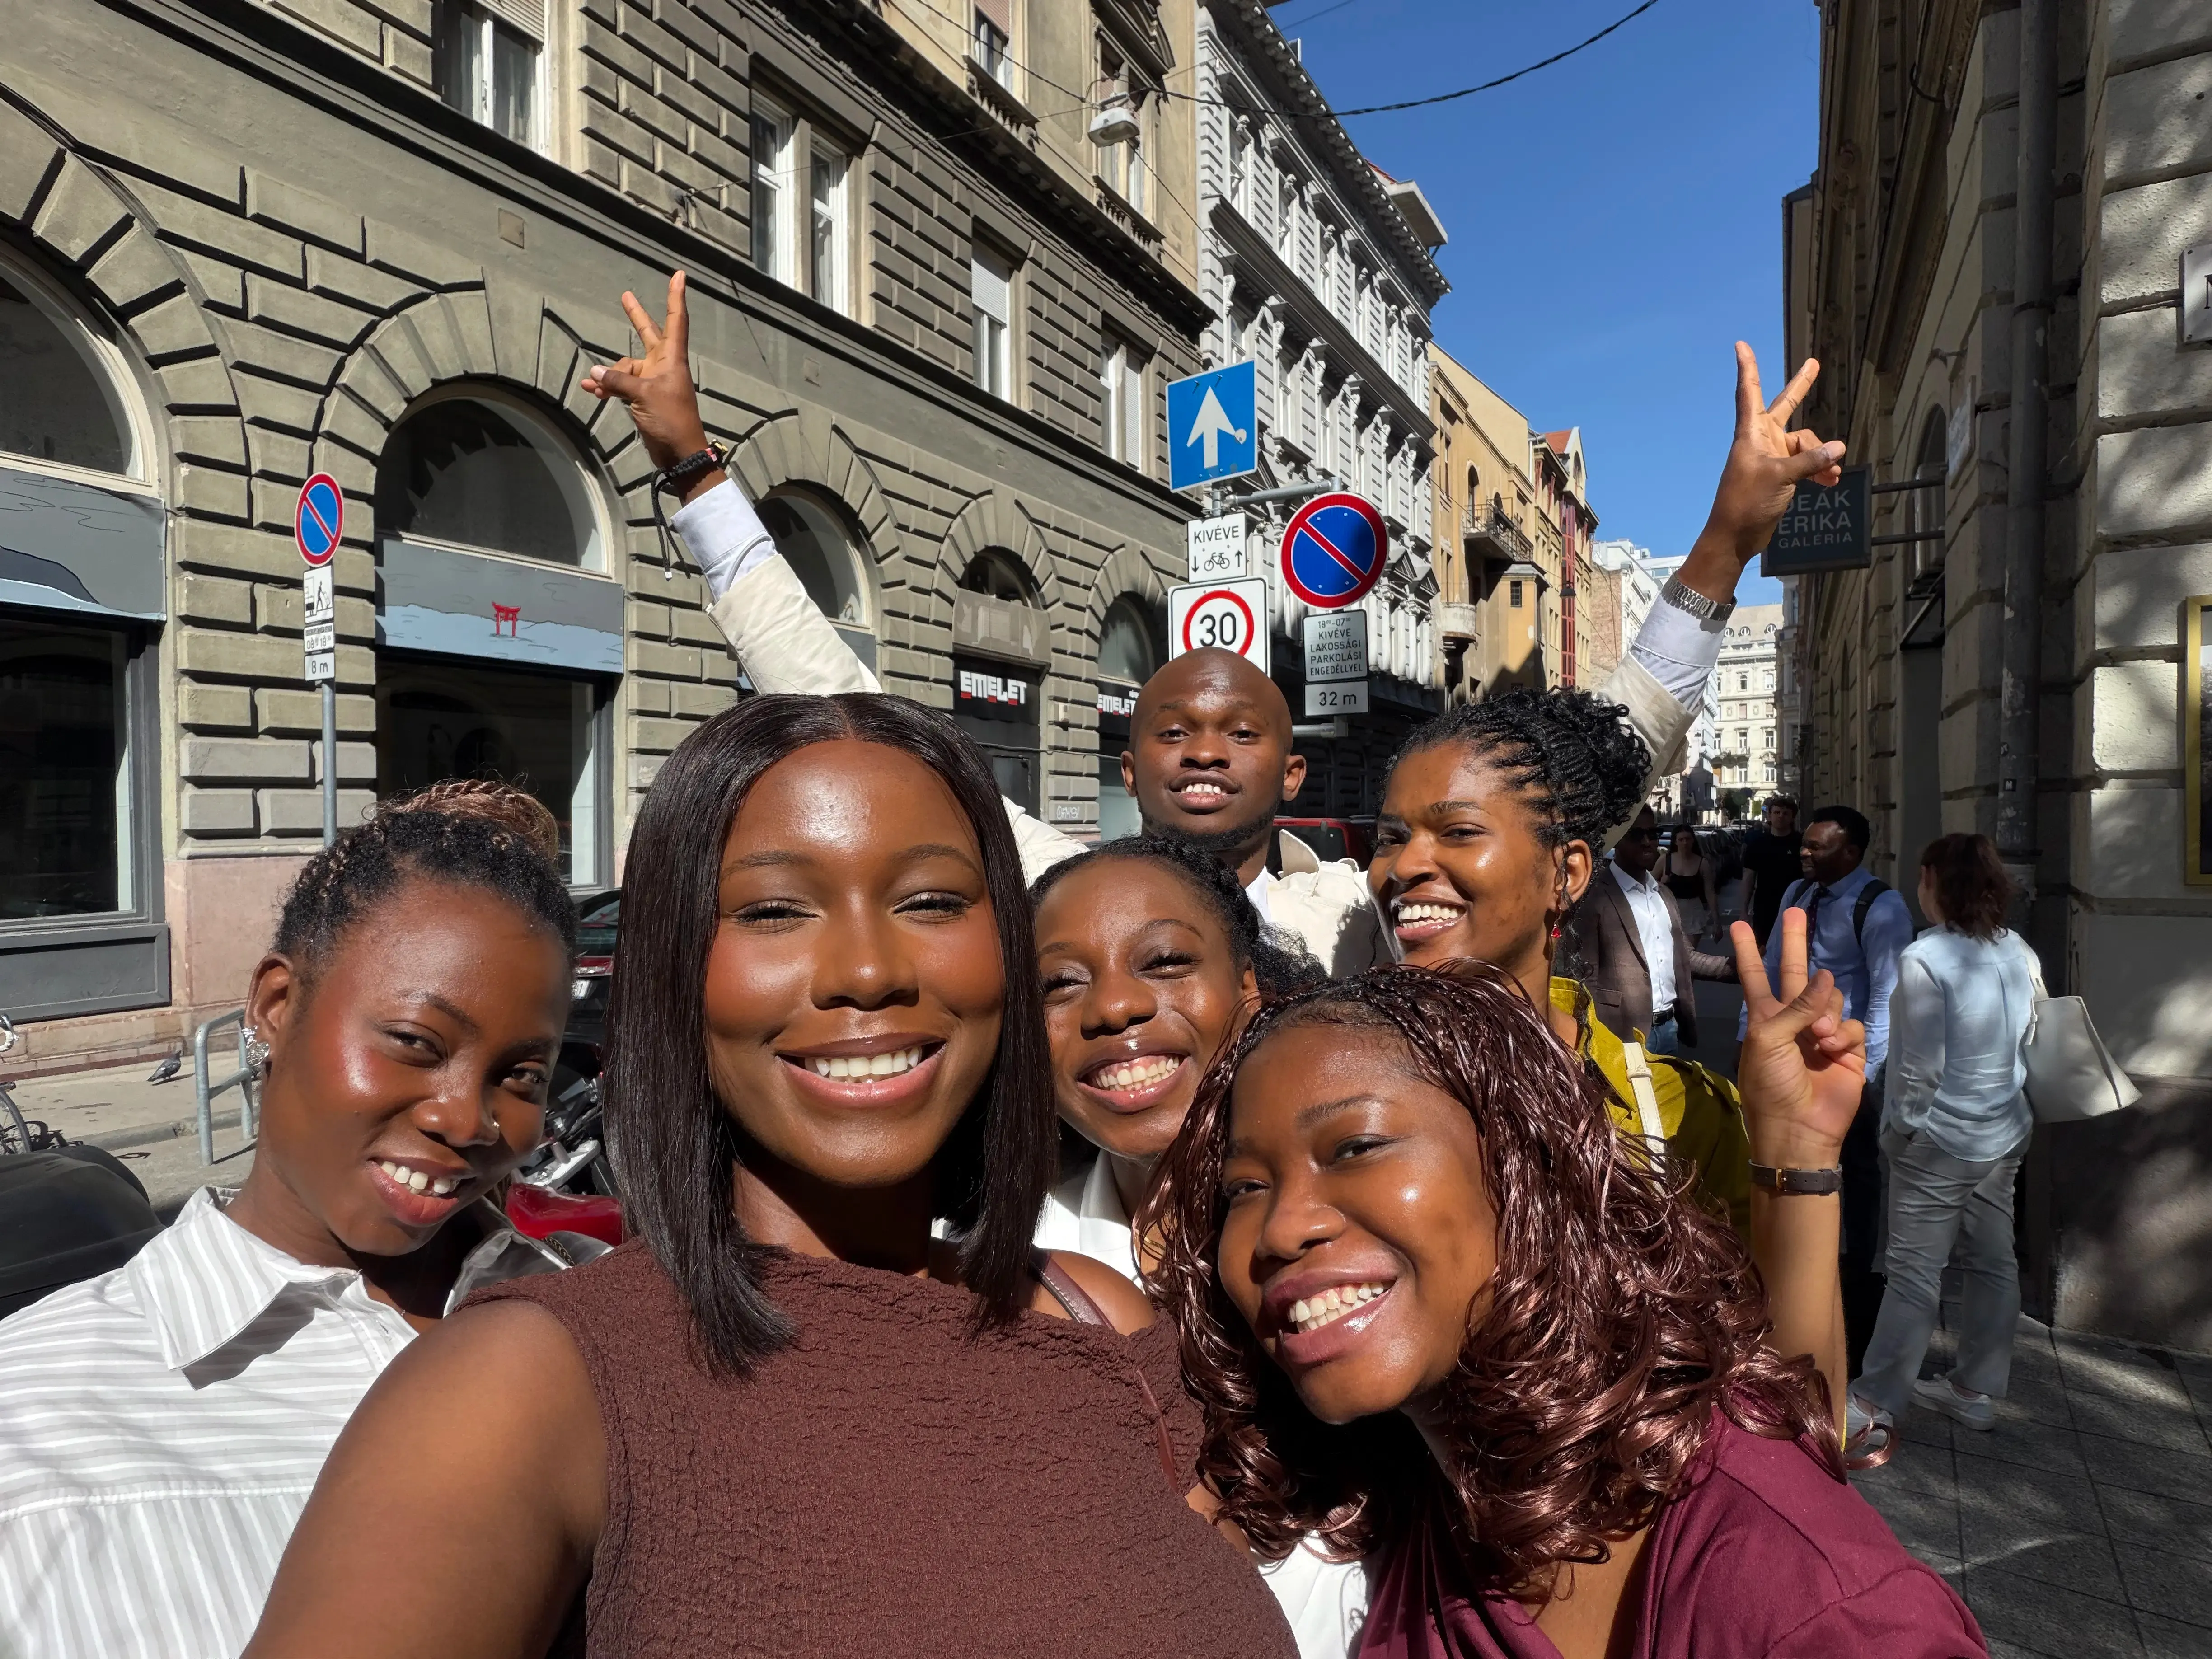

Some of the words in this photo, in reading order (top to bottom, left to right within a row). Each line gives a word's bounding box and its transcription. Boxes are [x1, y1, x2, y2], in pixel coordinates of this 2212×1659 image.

[1778, 511, 1852, 535] ERIKA
[1194, 524, 1239, 544] KIVÉVE
[1778, 532, 1853, 549] GALÉRIA
[1199, 611, 1237, 647] 30
[1318, 628, 1352, 640] KIVÉVE
[1310, 638, 1361, 652] LAKOSSÁGI
[1310, 650, 1362, 664] PARKOLÁSI
[311, 660, 316, 674] 8
[319, 662, 328, 673] m
[1310, 663, 1363, 676] ENGEDÉLLYEL
[960, 670, 1027, 705] EMELET
[1319, 691, 1337, 706] 32
[1343, 694, 1357, 705] m
